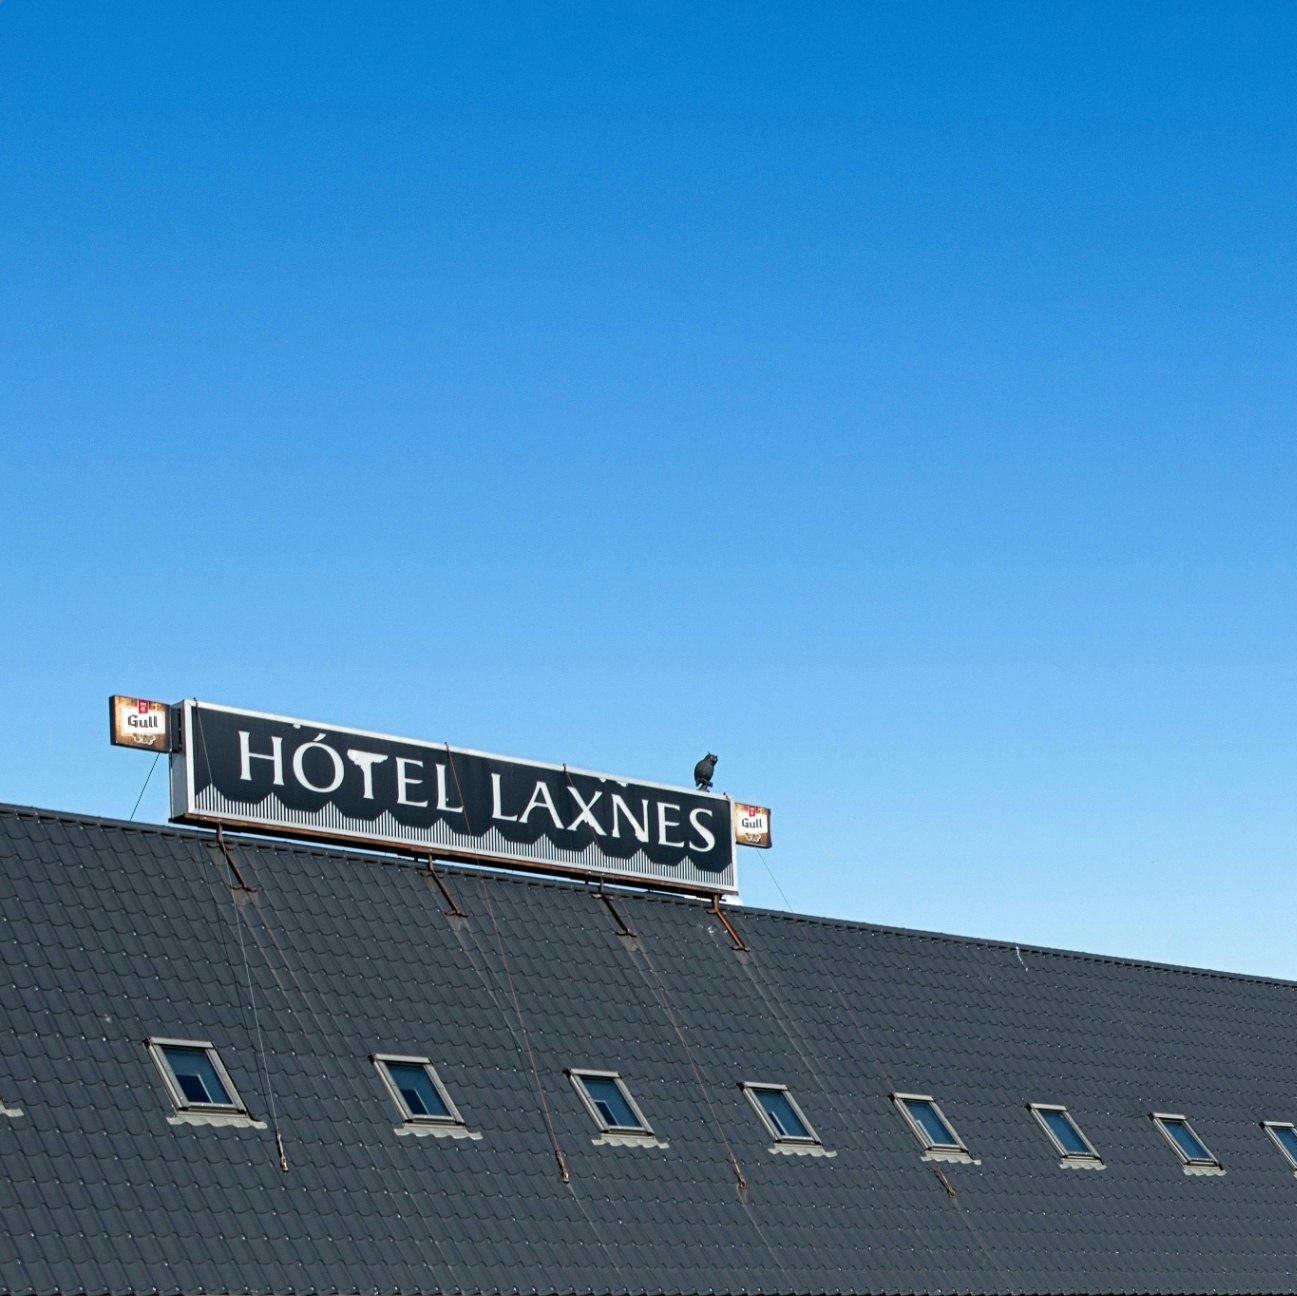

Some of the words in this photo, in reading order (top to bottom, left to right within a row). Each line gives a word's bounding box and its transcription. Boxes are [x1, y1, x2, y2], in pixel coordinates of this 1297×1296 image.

[127, 714, 158, 728] Gull
[238, 730, 464, 813] HÓTEL
[490, 772, 717, 853] LAXNES
[741, 817, 763, 829] Gull
